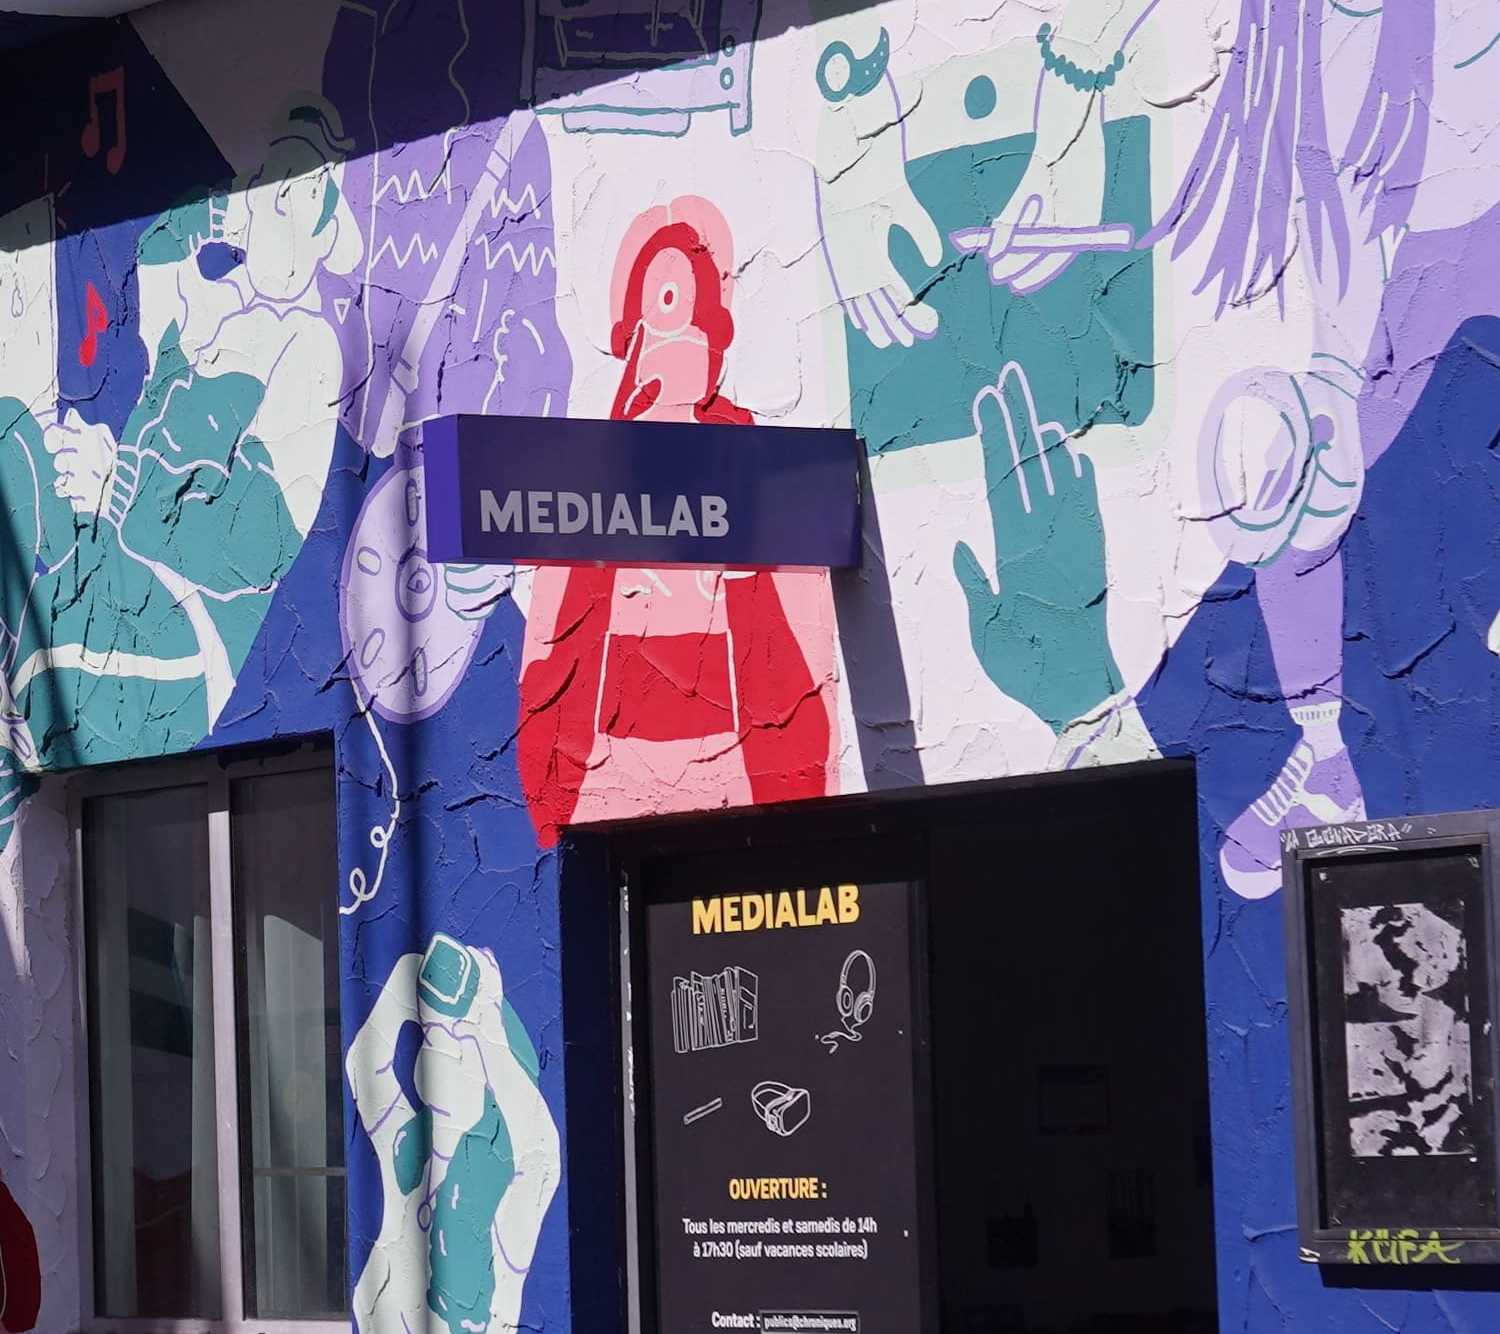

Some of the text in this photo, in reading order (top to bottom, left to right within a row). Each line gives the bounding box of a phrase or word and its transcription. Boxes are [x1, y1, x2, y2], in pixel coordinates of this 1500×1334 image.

[480, 490, 729, 537] MEDIALAB
[692, 885, 860, 935] MEDIALAB
[729, 1178, 818, 1199] OUVERTURE
[682, 1217, 878, 1234] Tous les mercredis et samedis de 14h
[693, 1239, 868, 1259] à 17h30 (sauf vacances scolaires)
[711, 1311, 755, 1328] Contact
